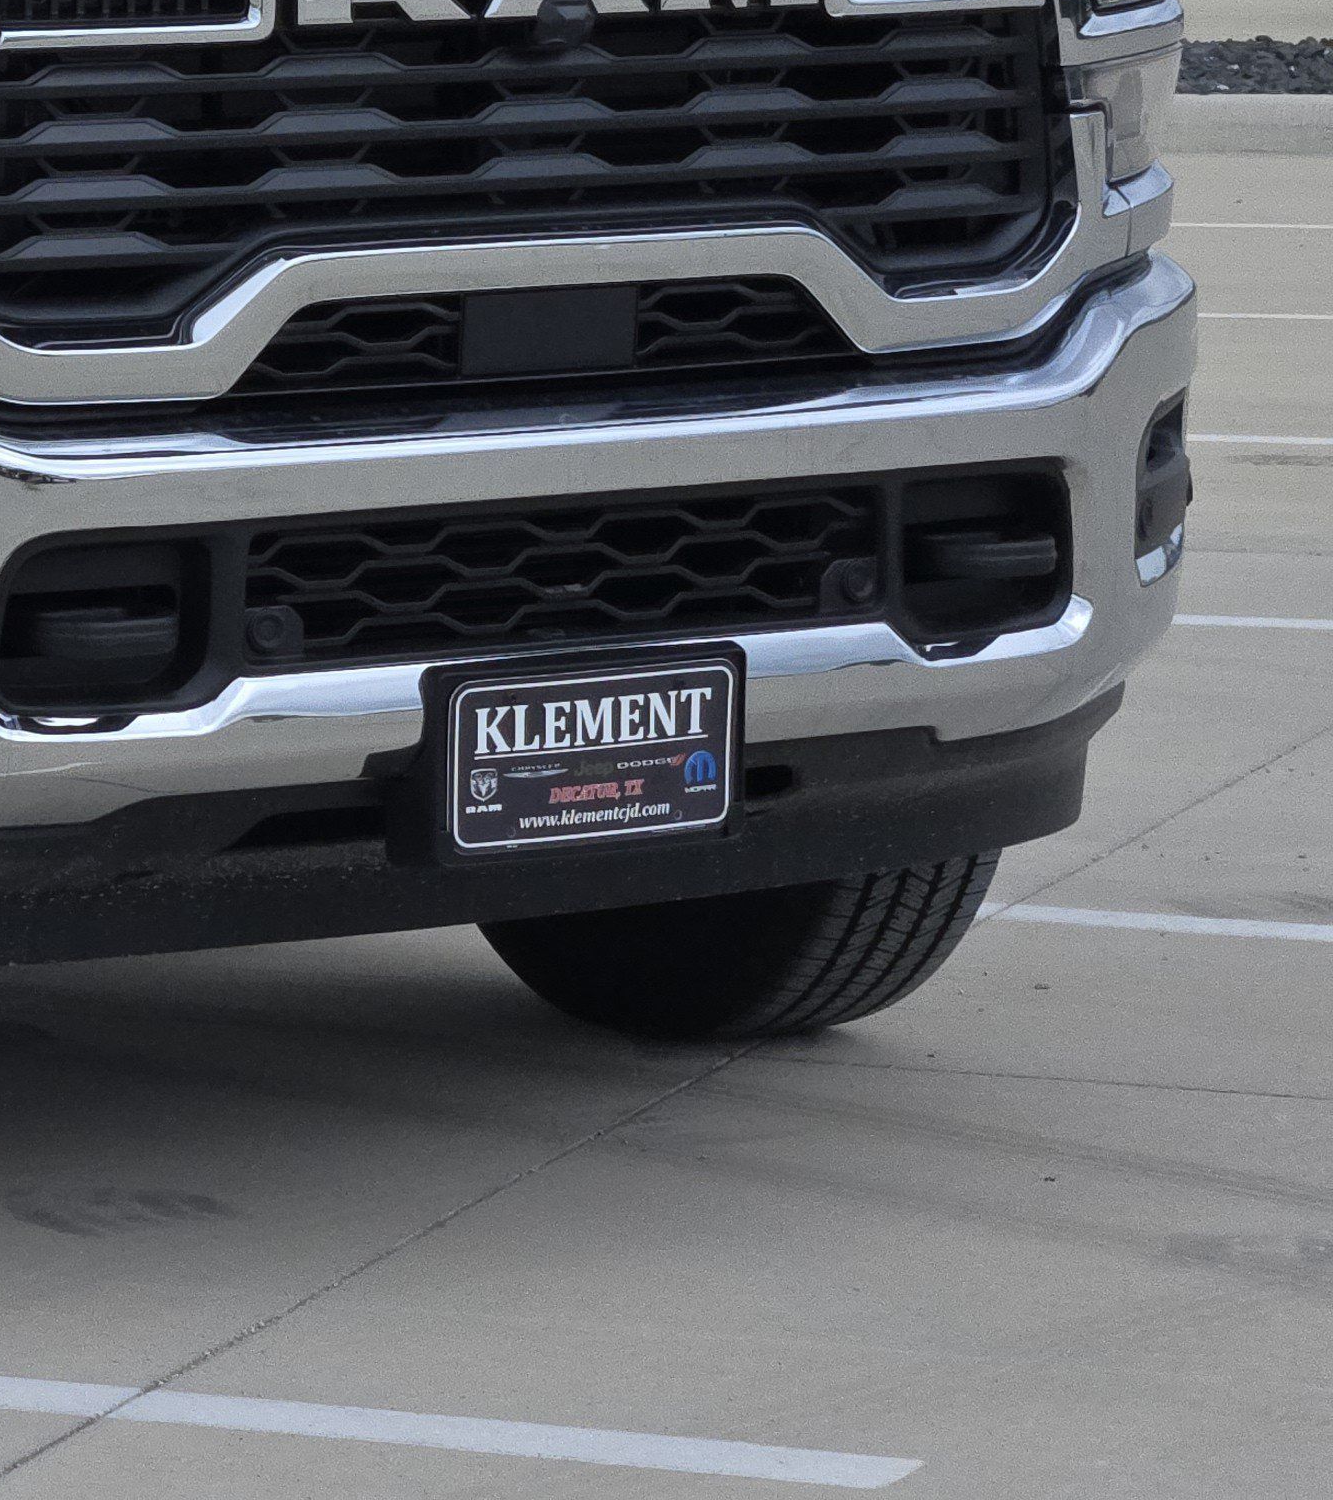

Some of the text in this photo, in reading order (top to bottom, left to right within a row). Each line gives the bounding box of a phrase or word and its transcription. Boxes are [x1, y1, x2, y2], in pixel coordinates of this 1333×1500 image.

[473, 687, 713, 754] KLEMENT
[624, 778, 645, 797] TX
[465, 804, 503, 814] RAM
[518, 802, 671, 829] www.klementcjd.com
